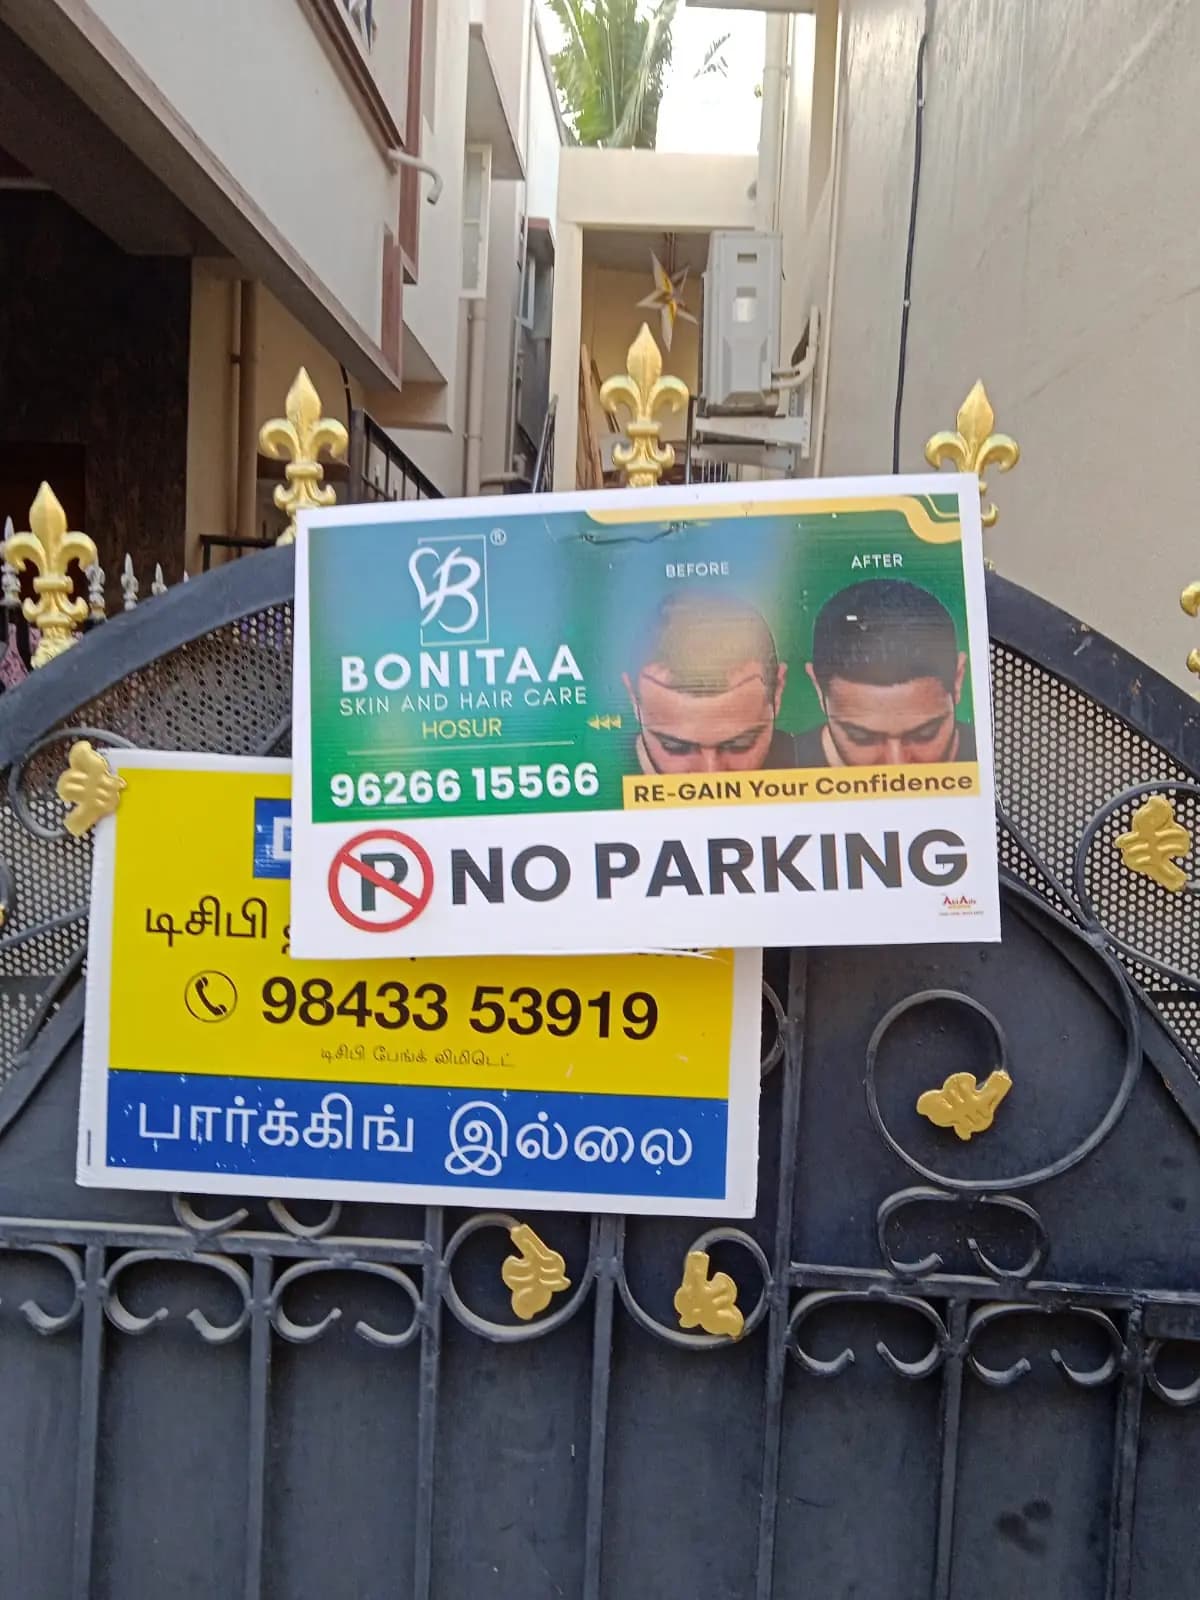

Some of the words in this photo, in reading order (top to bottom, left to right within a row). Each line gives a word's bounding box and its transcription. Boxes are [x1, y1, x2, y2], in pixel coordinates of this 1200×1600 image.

[665, 561, 729, 578] BEFORE
[850, 553, 903, 569] AFTER
[341, 644, 584, 693] BONITAA
[340, 698, 389, 717] SKIN
[401, 694, 448, 712] AND
[461, 690, 513, 709] HAIR
[525, 687, 587, 706] CARE
[422, 717, 502, 740] HOSUR
[329, 768, 461, 807] 96266
[472, 763, 599, 801] 15566
[633, 780, 741, 802] RE-GAIN
[749, 778, 809, 797] Your
[815, 773, 973, 795] Confidence
[450, 844, 572, 905] NO
[595, 828, 968, 899] PARKING
[145, 895, 268, 948] டிசிபி
[262, 976, 448, 1032] 98433
[469, 985, 659, 1041] 53919
[138, 1092, 415, 1153] பார்க்கிங்
[444, 1100, 694, 1177] இல்லை
